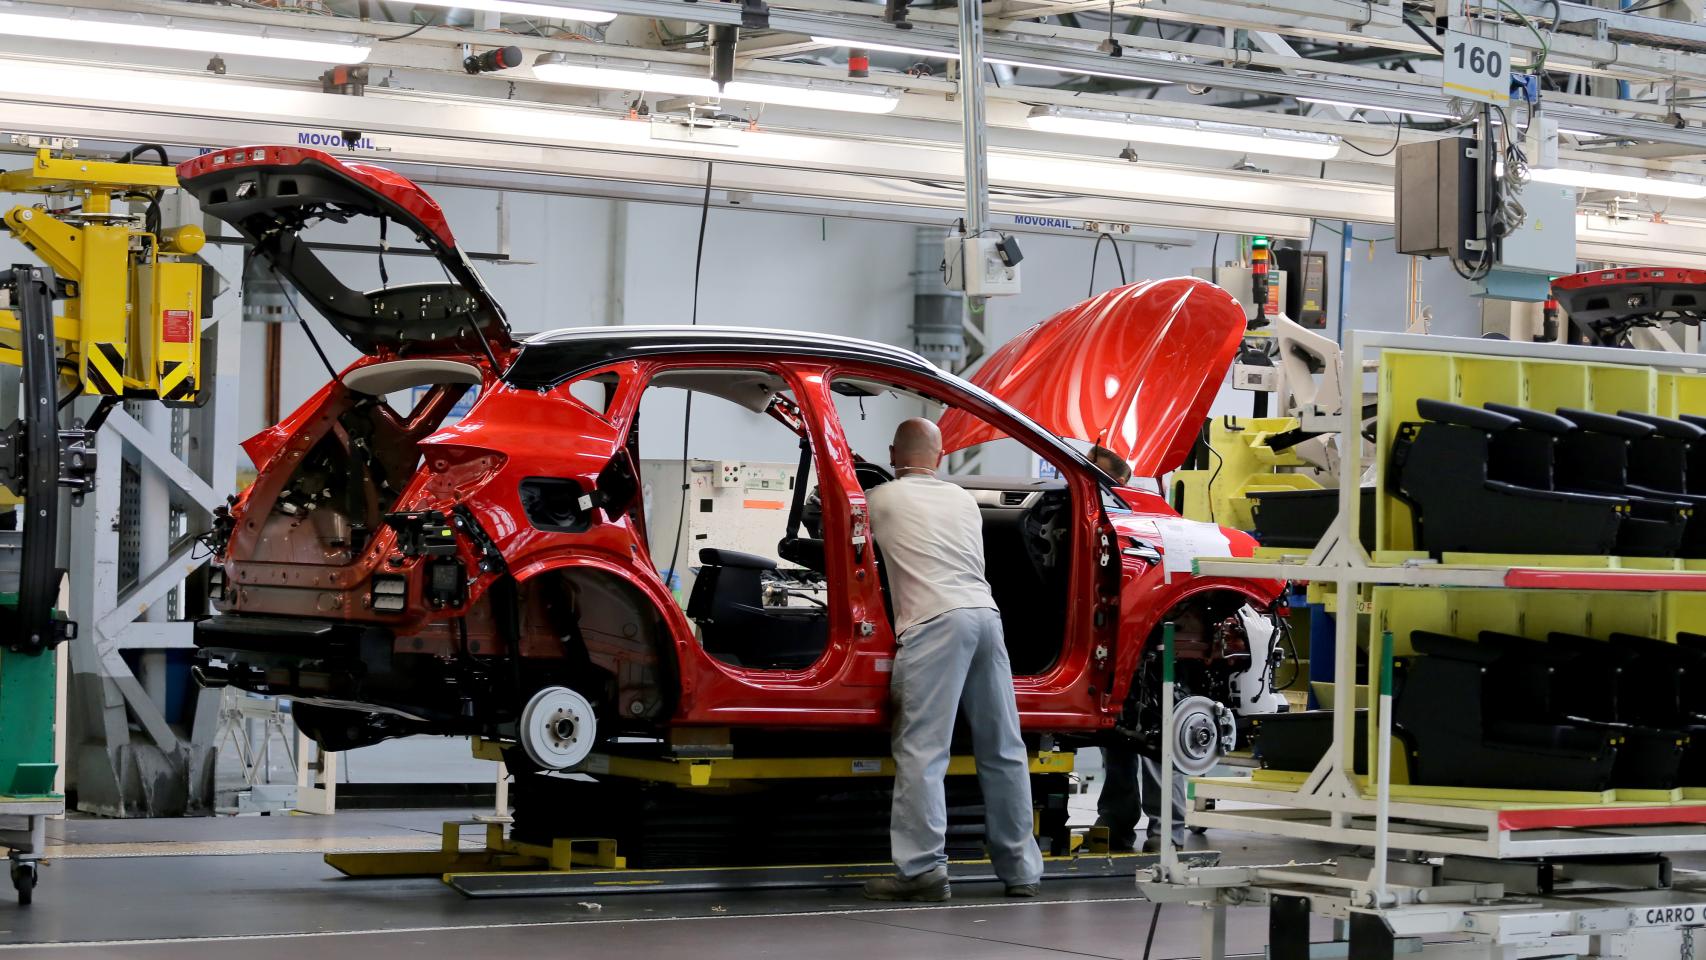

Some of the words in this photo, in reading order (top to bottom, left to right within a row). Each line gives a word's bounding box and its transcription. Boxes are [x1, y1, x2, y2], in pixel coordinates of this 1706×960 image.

[1454, 42, 1502, 78] 160
[1014, 214, 1072, 229] MOVORAIL
[1646, 907, 1695, 924] CARRO
